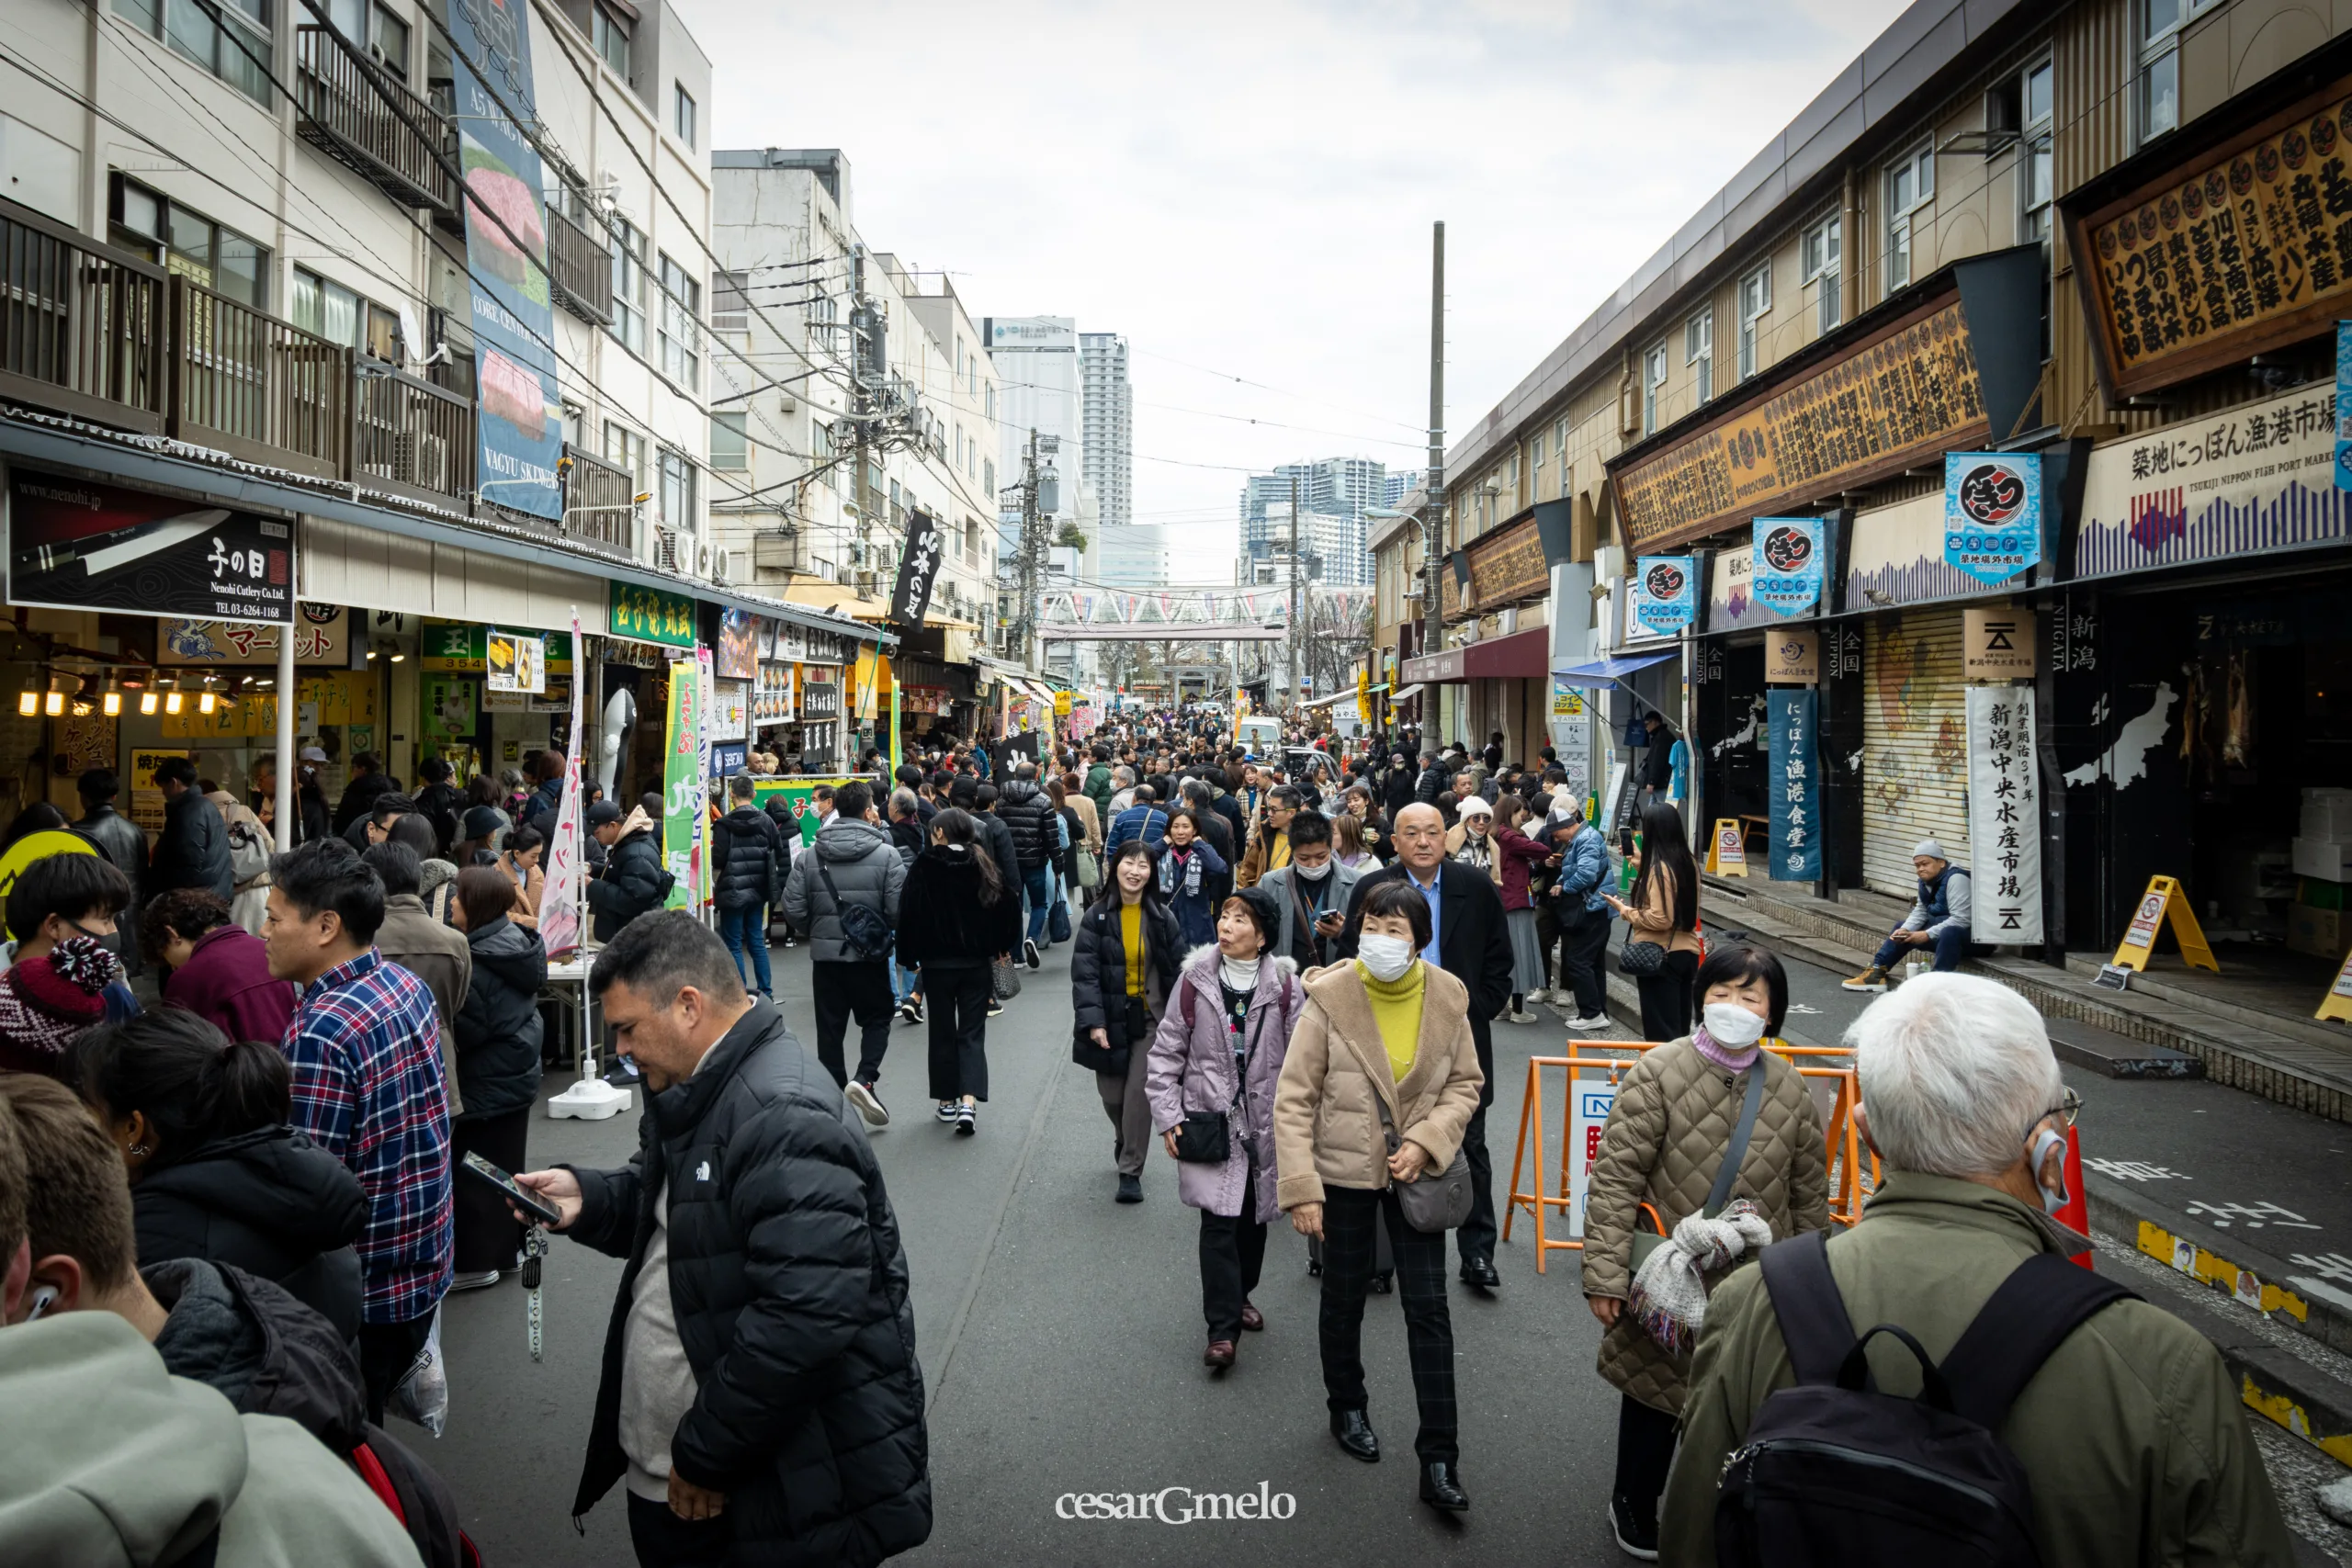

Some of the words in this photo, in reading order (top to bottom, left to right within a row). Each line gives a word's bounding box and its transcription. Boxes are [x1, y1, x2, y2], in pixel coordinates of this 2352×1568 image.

[470, 86, 485, 116] A5
[473, 295, 499, 323] CORE
[500, 310, 531, 344] CENTER
[484, 446, 518, 478] WAGYU
[2189, 480, 2218, 494] TSUKIJI
[2222, 469, 2252, 486] NIPPON
[2278, 459, 2301, 474] PORT
[2304, 450, 2335, 468] MARKE
[18, 482, 102, 512] www.nenohi.jp
[208, 536, 265, 579] 子の日
[1960, 554, 2024, 565] 築地場外市場
[211, 582, 236, 596] Nenohi
[237, 585, 261, 601] Cutlery
[216, 603, 230, 615] TEL
[231, 604, 279, 618] 03-6264-1168
[225, 628, 332, 658] マーット
[1830, 632, 1838, 677] NIPPON
[1843, 631, 1860, 673] 全国
[2053, 605, 2064, 671] NIIGATA
[2071, 615, 2098, 671] 新潟
[1969, 659, 2031, 667] 新潟中央水産市場
[1785, 702, 1808, 848] にっぽん漁港食堂
[1989, 704, 2021, 898] 新潟中央水産市場
